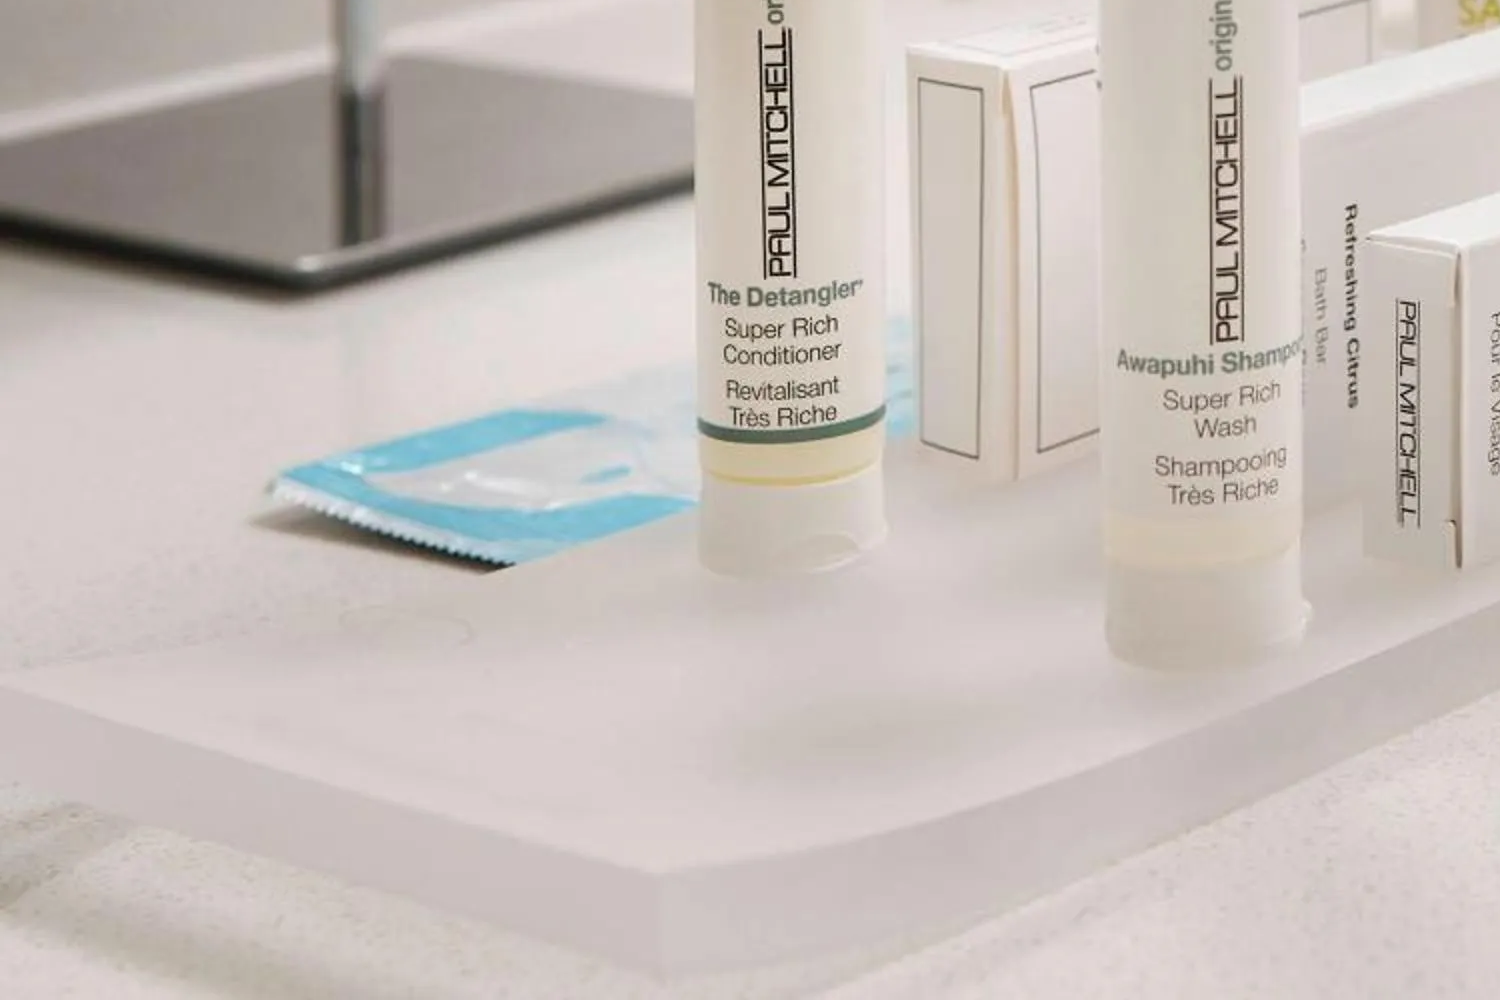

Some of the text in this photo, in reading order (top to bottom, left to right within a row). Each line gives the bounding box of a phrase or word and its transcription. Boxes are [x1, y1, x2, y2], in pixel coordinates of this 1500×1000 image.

[763, 26, 792, 278] PAUL MITCHELL
[1214, 74, 1239, 344] PAUL MITCHELL
[706, 281, 741, 307] The
[1343, 203, 1360, 409] Refreshing Citrus
[724, 313, 839, 343] Super Rich
[1313, 267, 1328, 365] Bath Bar
[723, 341, 843, 366] Conditioner
[1116, 348, 1215, 380] Awapuhi
[726, 375, 840, 401] Revitalisant
[1162, 380, 1281, 412] Super Rich
[729, 403, 837, 427] Très Riche
[1193, 414, 1257, 440] Wash
[1398, 300, 1417, 526] PAUL MITCHELL
[1154, 447, 1288, 478] Shampooing
[1168, 476, 1280, 506] Très Riche
